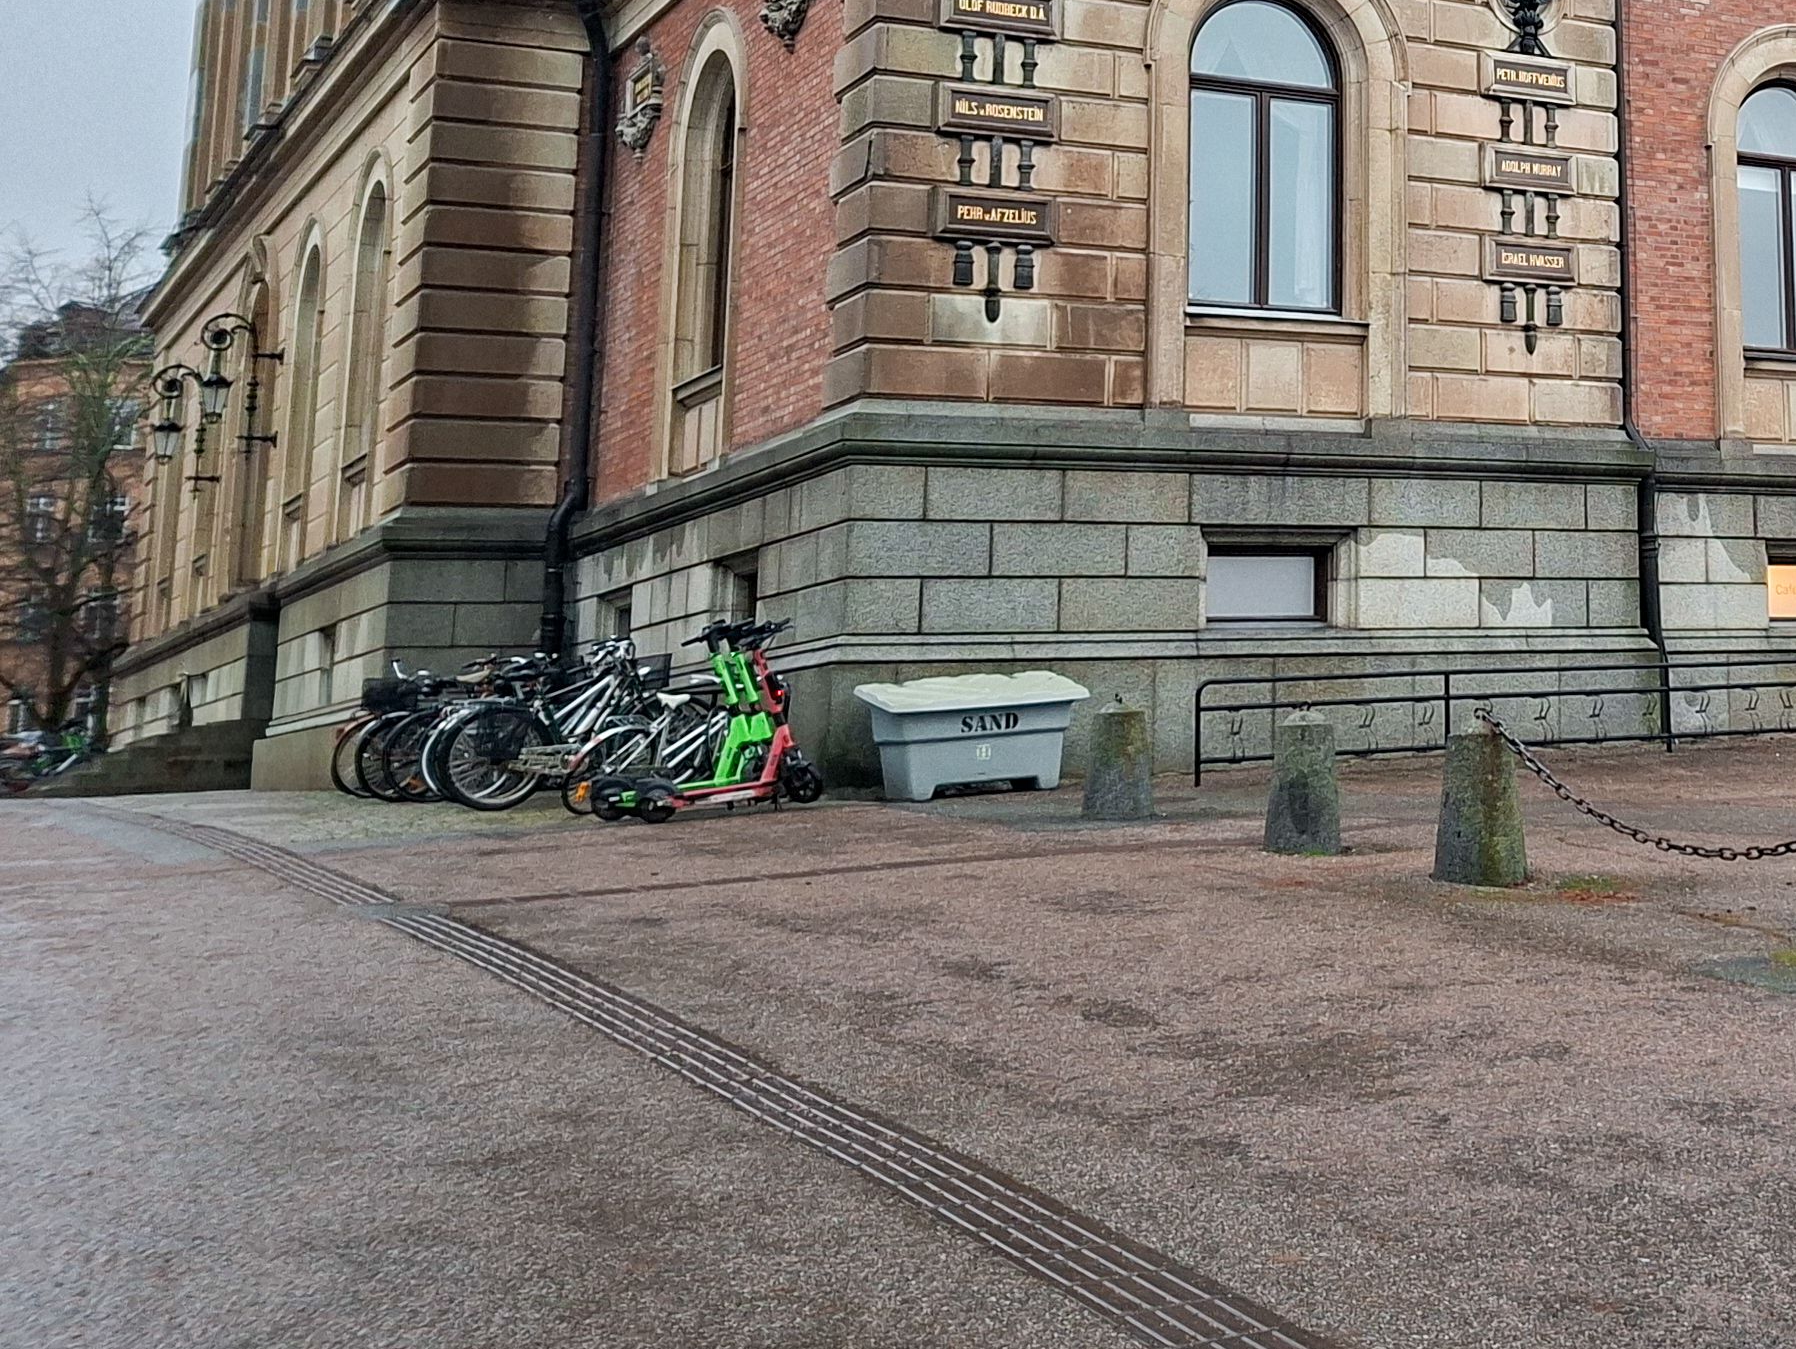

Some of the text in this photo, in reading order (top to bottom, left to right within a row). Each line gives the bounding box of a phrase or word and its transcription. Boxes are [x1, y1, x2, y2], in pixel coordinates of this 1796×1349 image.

[986, 0, 1027, 18] RUDBECK
[955, 98, 978, 115] NILS
[1501, 160, 1561, 177] ADOLPH MURRAY
[957, 205, 983, 220] PEHR
[1501, 249, 1528, 265] ISRAEL
[960, 712, 1019, 733] SAND
